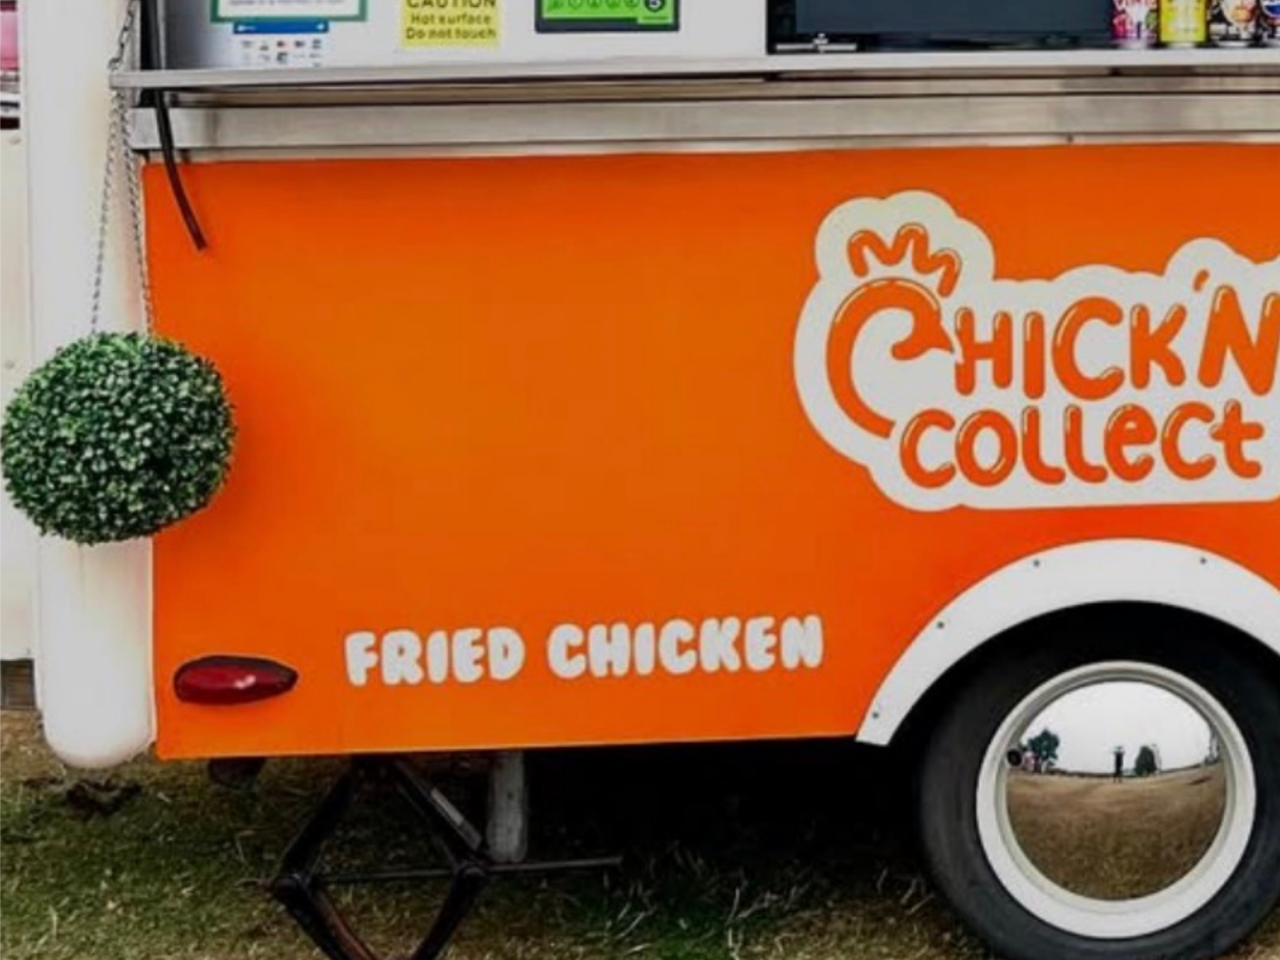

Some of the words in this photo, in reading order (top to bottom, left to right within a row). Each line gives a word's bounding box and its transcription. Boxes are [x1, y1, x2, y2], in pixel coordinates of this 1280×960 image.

[410, 13, 434, 26] Hot
[438, 12, 491, 25] surface
[406, 26, 425, 39] Do
[455, 27, 497, 39] touch
[345, 628, 527, 687] FRIED
[547, 615, 824, 680] CHICKEN
